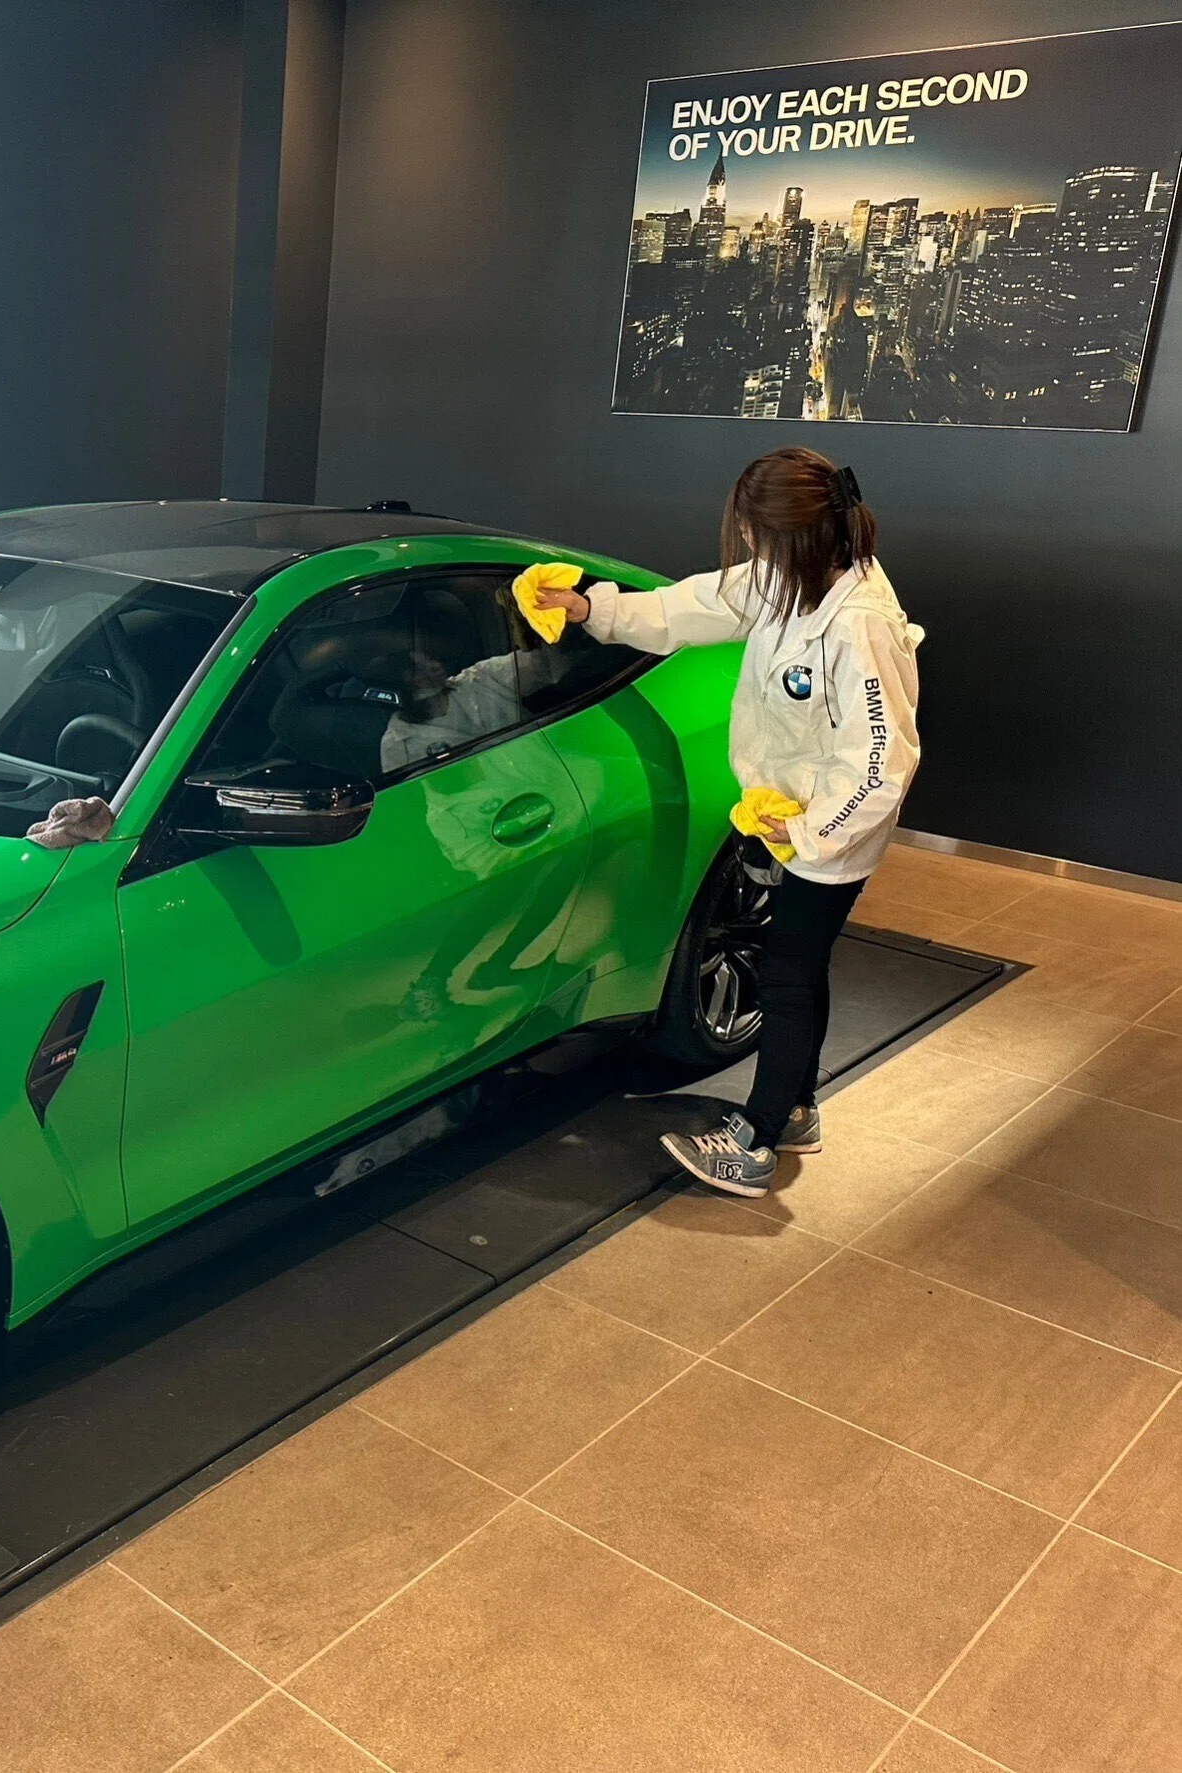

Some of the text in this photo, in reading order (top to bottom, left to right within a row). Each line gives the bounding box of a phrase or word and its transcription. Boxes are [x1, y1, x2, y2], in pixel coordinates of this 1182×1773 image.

[672, 69, 1029, 129] ENJOY EACH SECOND
[668, 115, 916, 161] OF YOUR DRIVE.
[864, 678, 885, 723] BMW
